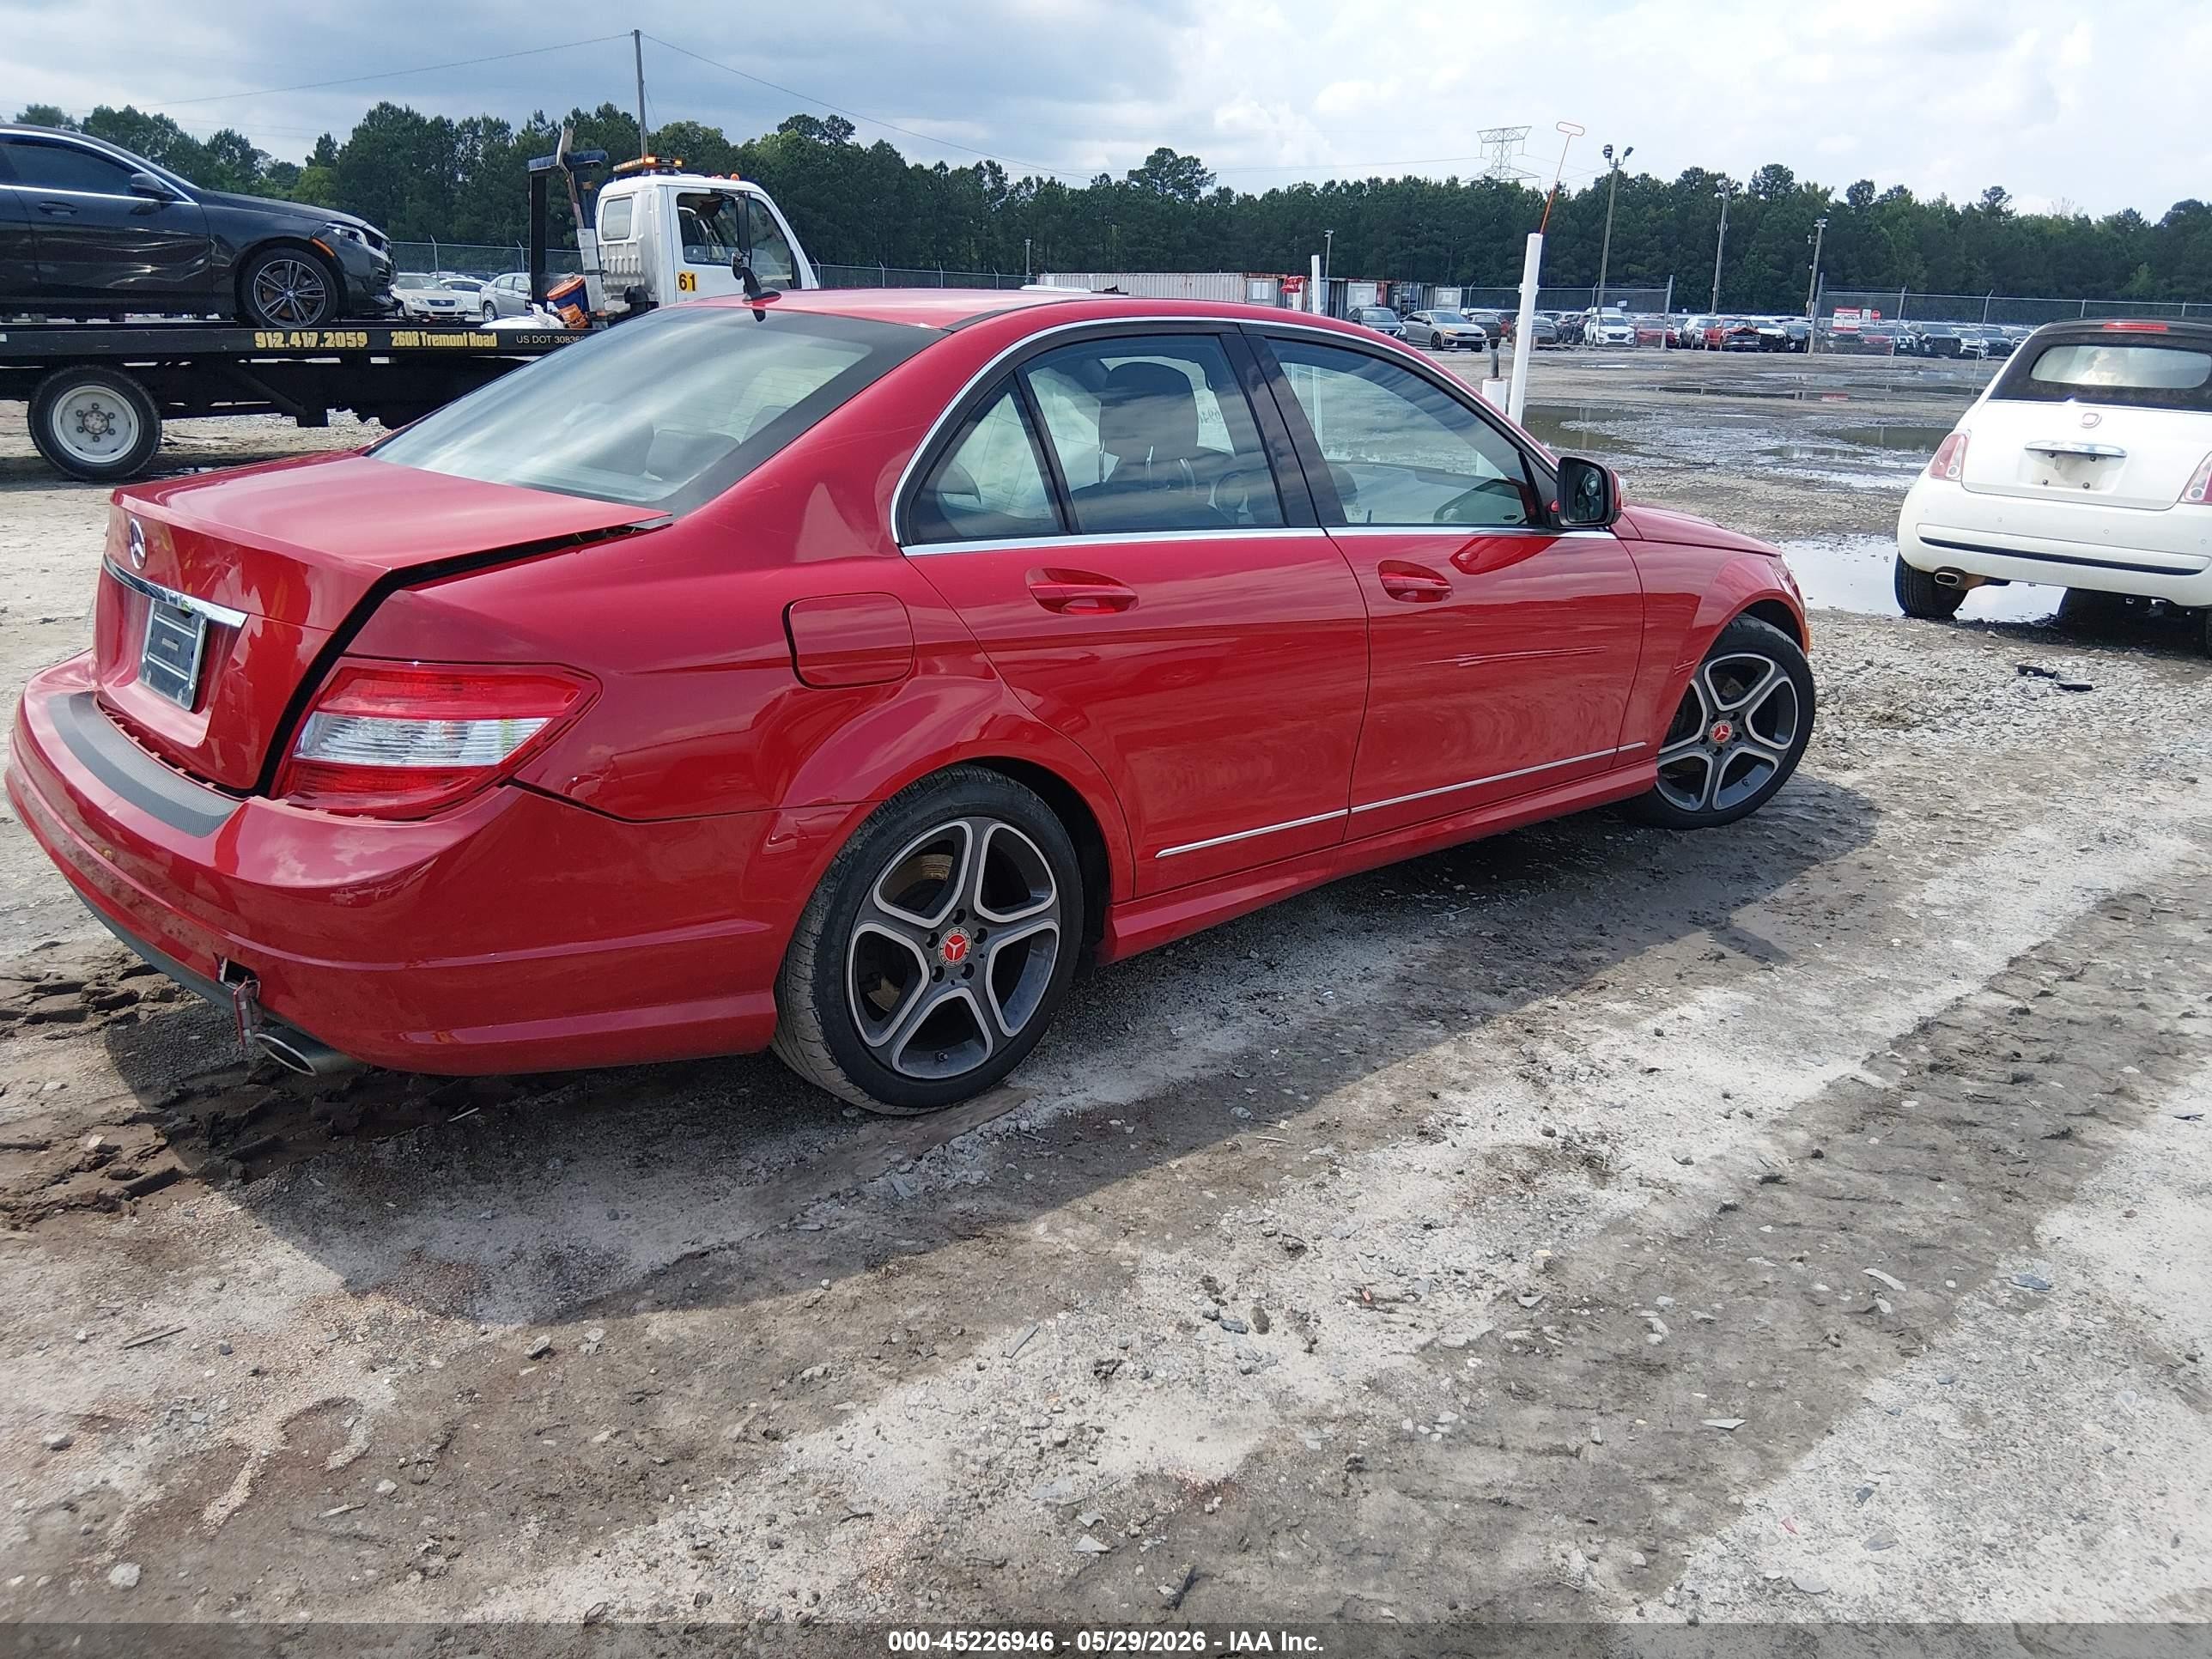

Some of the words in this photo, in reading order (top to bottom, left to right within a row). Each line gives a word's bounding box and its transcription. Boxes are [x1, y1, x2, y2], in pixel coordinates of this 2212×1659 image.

[678, 273, 696, 292] 61
[254, 331, 368, 349] 912.417.2059
[390, 331, 420, 347] 2608
[420, 331, 468, 347] Tremont
[468, 331, 498, 347] Road
[516, 335, 530, 344] US
[532, 335, 552, 344] DOT
